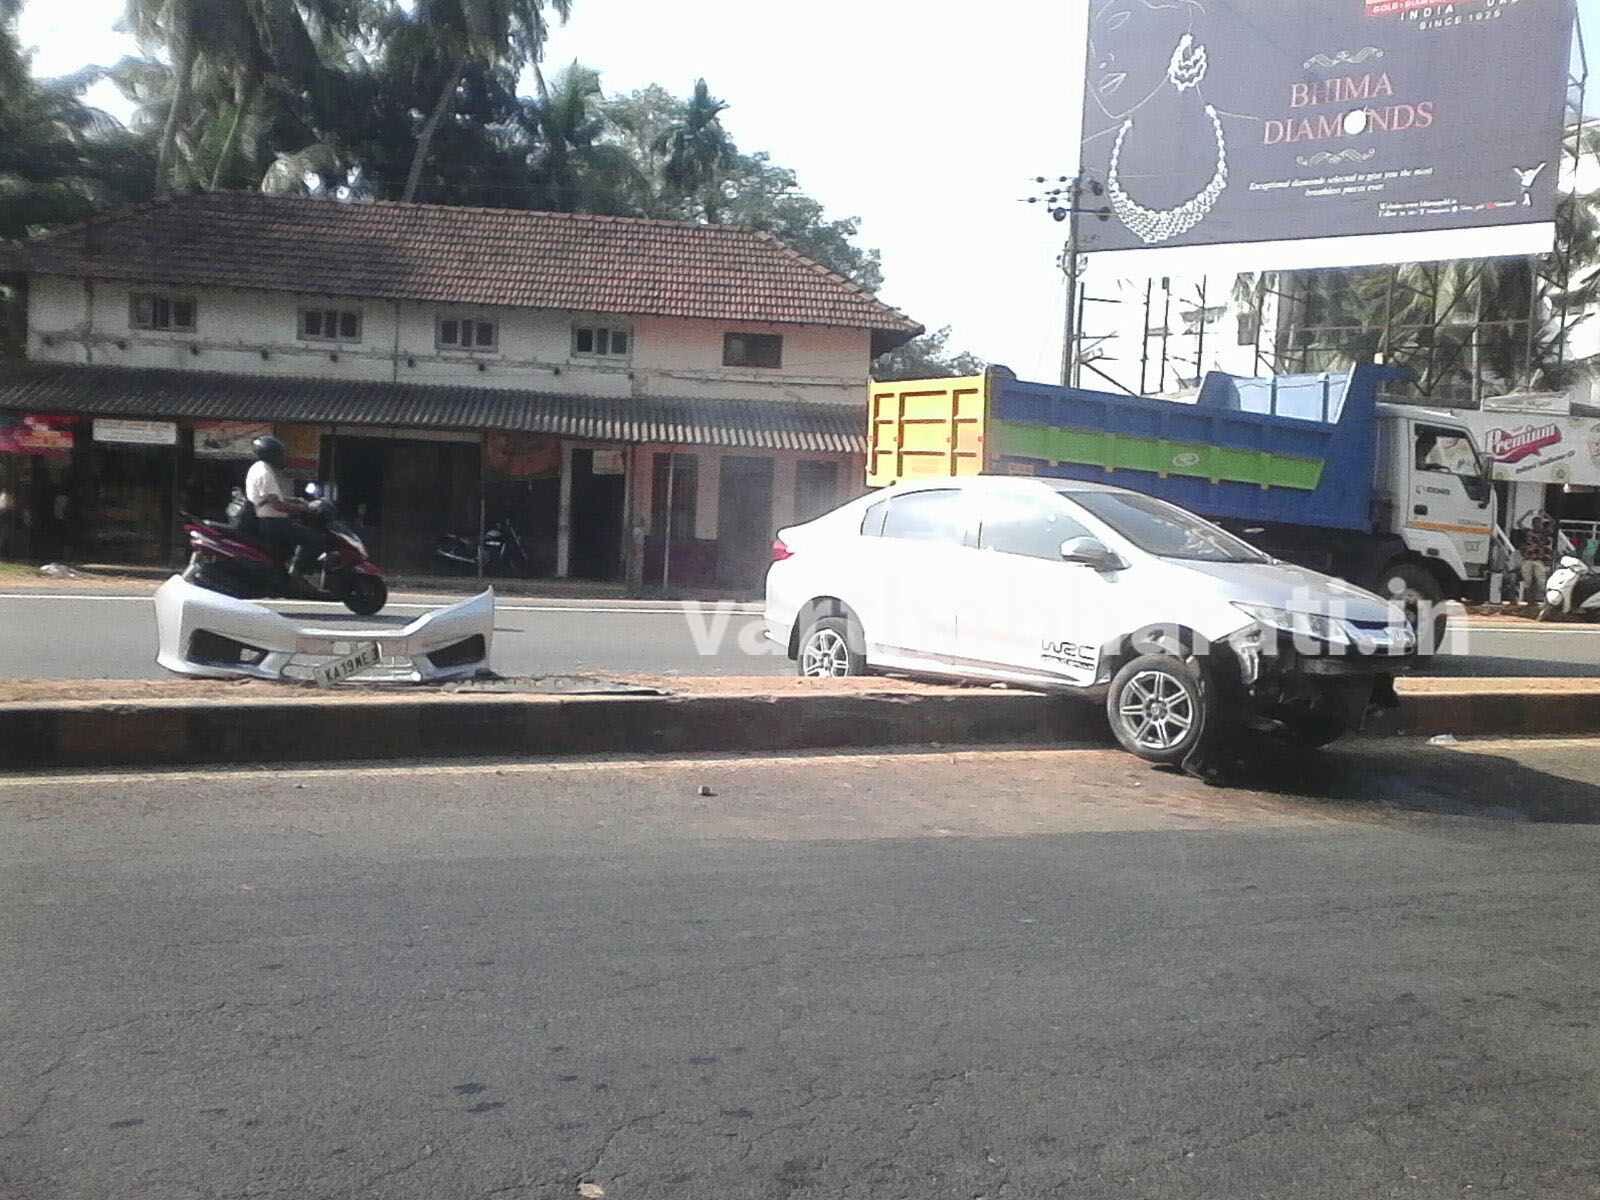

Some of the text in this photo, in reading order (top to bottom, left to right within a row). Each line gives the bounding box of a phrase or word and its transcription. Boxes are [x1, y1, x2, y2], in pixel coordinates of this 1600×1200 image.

[1400, 4, 1454, 21] INDIA
[1419, 16, 1463, 30] SINCE
[1289, 72, 1394, 109] BHIMA
